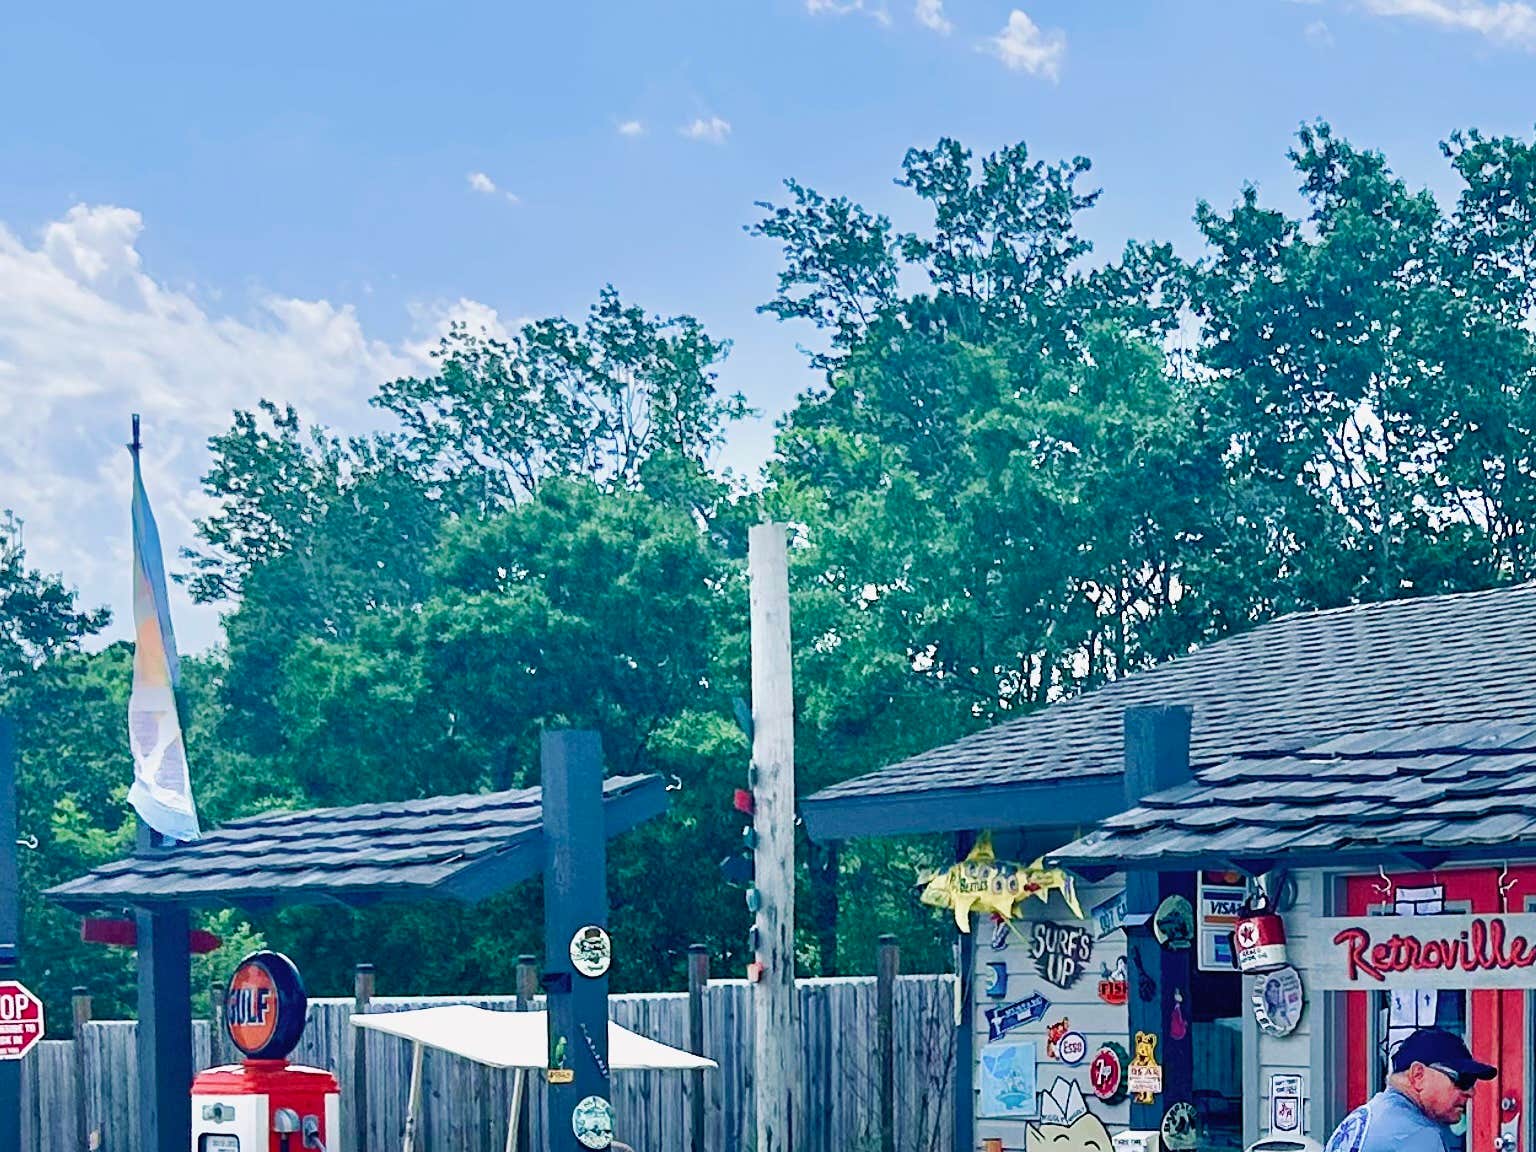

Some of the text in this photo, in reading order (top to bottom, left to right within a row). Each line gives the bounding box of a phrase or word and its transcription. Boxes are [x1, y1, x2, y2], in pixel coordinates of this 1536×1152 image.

[1210, 901, 1236, 914] VISA
[1032, 924, 1090, 959] SURF'S
[1048, 953, 1076, 986] UP
